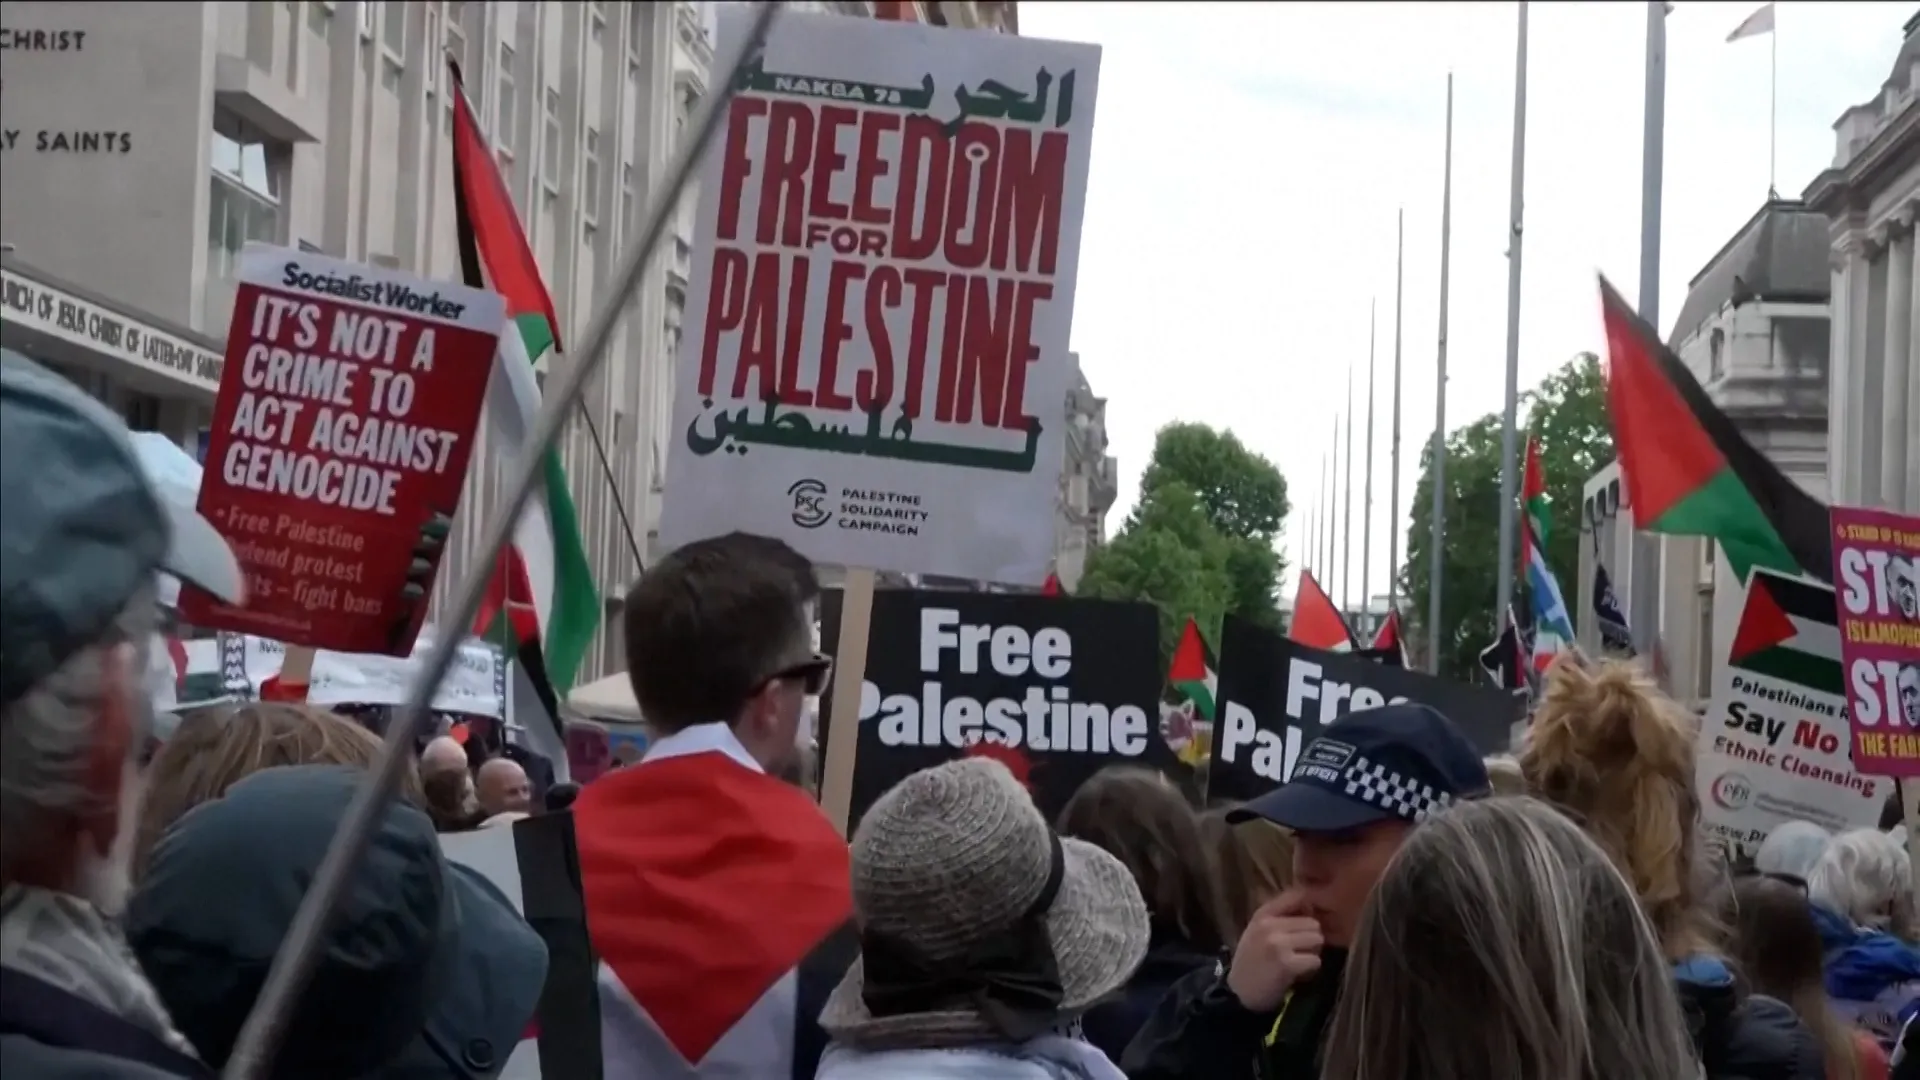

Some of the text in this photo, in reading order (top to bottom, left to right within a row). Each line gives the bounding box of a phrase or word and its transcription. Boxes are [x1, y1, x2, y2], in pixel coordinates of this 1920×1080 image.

[775, 76, 865, 99] NAKBA
[0, 129, 132, 153] Y SAINTS
[716, 97, 1069, 275] FREEDOM
[807, 222, 887, 257] FOR
[38, 292, 53, 321] OF
[56, 299, 87, 335] JESUS
[283, 262, 466, 320] Socialist Worker
[250, 292, 436, 373] IT'S NOT A
[698, 247, 1054, 430] PALESTINE
[242, 343, 416, 417] CRIME TO
[230, 391, 458, 475] ACT AGAINST
[223, 441, 402, 515] GENOCIDE
[842, 487, 922, 506] PALESTINE
[228, 505, 365, 552] Free Palestine
[838, 517, 919, 537] CAMPAIGN
[840, 502, 929, 522] SOLIDARITY
[291, 554, 364, 585] protest
[920, 607, 1072, 679] Free
[1286, 657, 1408, 725] Fre
[1731, 675, 1835, 719] Palestinians
[1724, 701, 1839, 755] Say No
[1857, 731, 1887, 758] THE
[1713, 734, 1877, 799] Ethnic Cleansing
